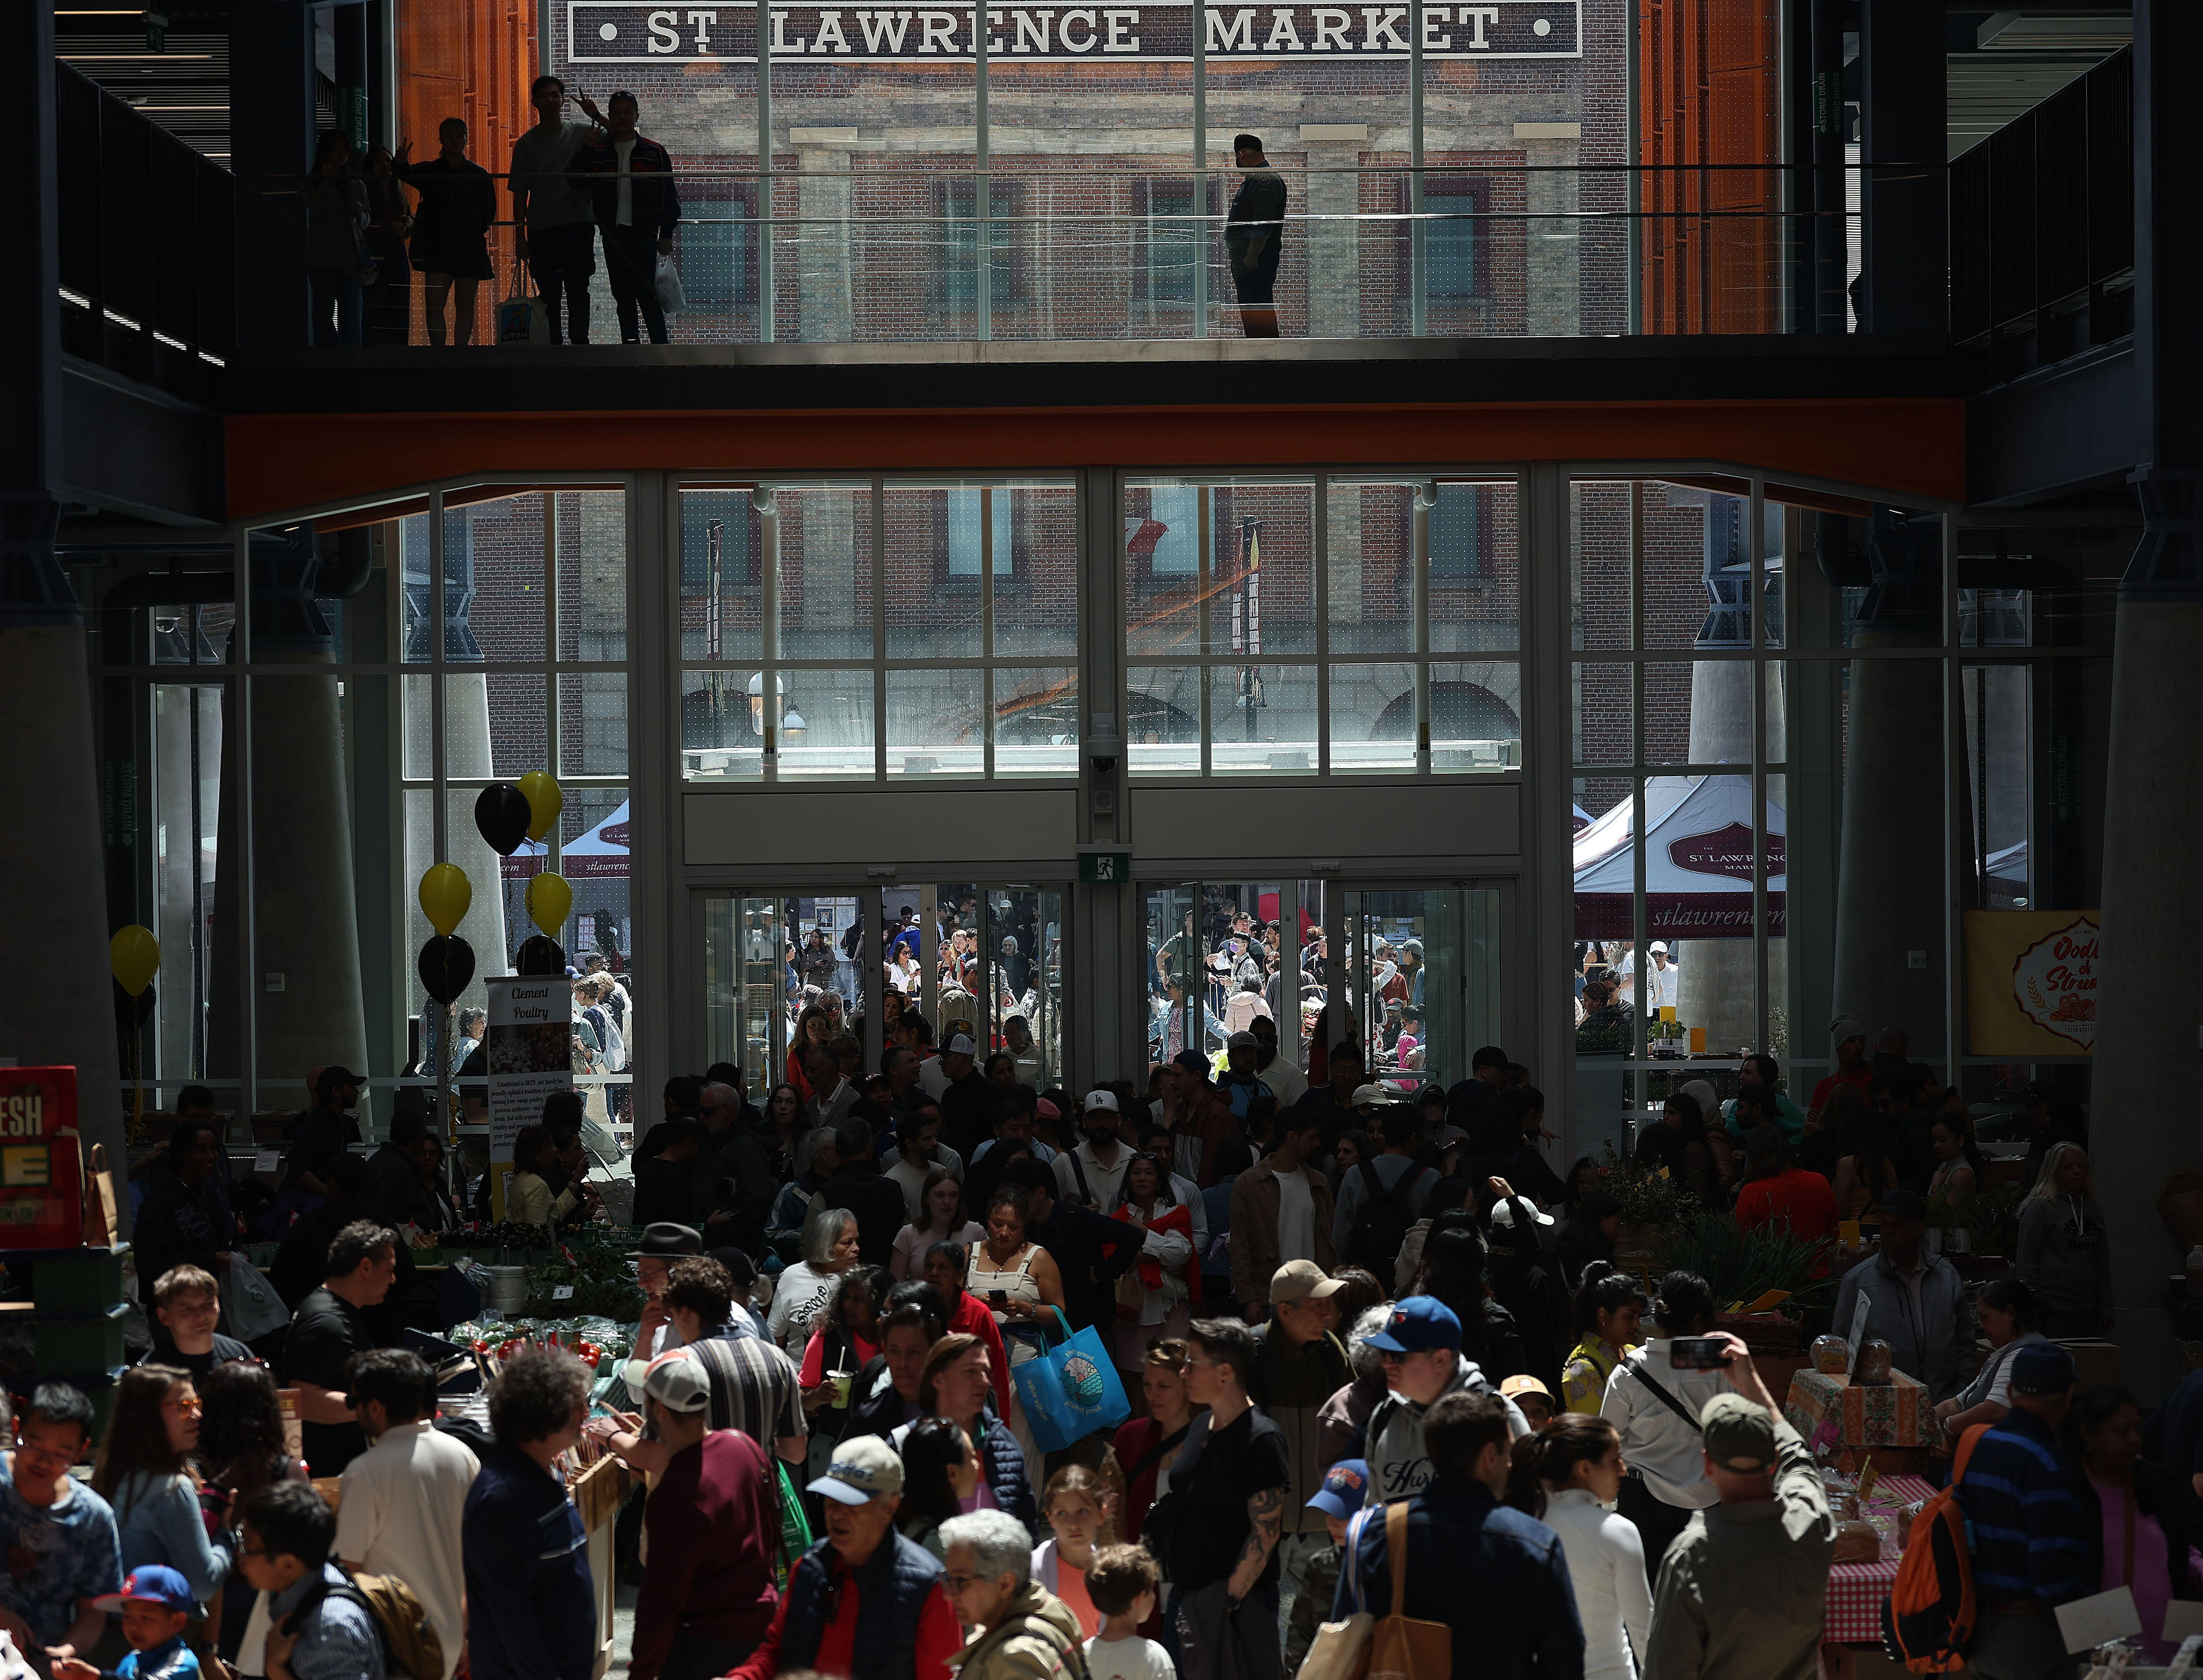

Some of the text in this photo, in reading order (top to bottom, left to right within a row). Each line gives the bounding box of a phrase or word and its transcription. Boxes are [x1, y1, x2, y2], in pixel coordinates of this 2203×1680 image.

[770, 10, 1140, 54] LAWRENCE
[1205, 7, 1499, 52] MARKET
[504, 331, 528, 340] UTAH
[122, 762, 132, 830] STORM DRAIN
[512, 987, 548, 1000] Clement
[513, 1007, 548, 1021] Poultry
[491, 1090, 507, 1098] proudly
[1096, 1095, 1103, 1104] LA
[493, 1124, 507, 1132] vitality
[1027, 1379, 1049, 1421] value village
[1065, 1400, 1084, 1413] planet
